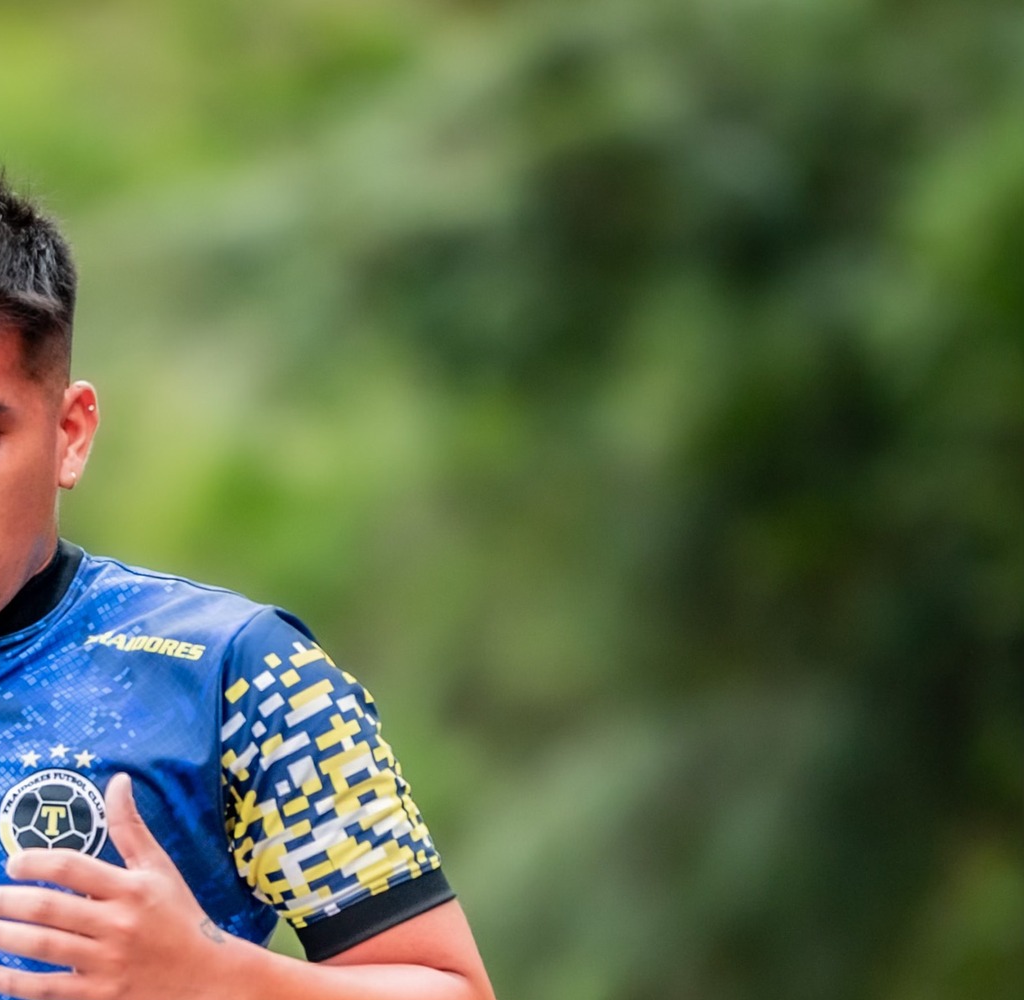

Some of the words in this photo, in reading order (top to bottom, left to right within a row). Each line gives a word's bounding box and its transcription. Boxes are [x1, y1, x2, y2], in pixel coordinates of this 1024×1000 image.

[53, 772, 87, 792] FUTBOL
[87, 790, 106, 819] CLUB
[40, 805, 67, 837] T
